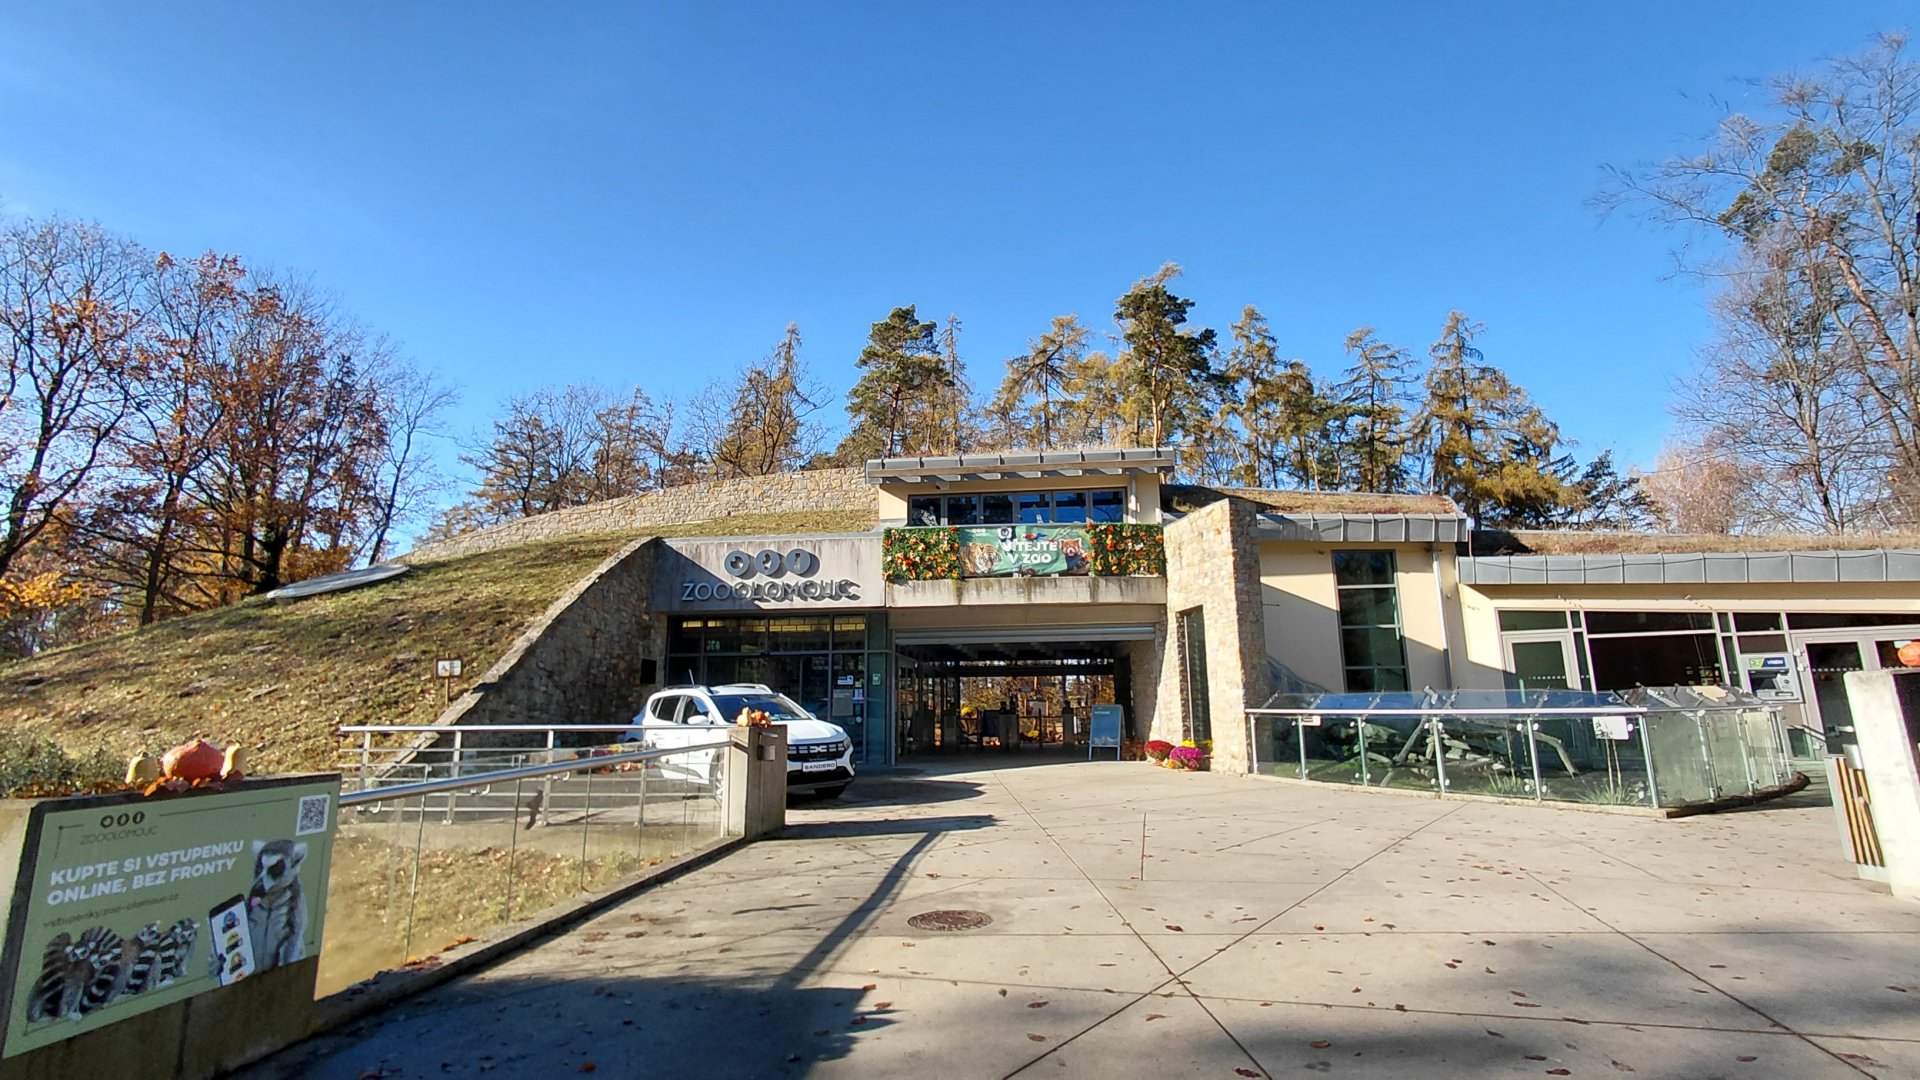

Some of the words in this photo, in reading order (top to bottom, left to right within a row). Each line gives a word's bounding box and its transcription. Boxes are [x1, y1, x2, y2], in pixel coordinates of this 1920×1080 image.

[1007, 553, 1019, 564] V
[1022, 553, 1052, 564] ZOO
[47, 878, 128, 906] ONLINE,
[132, 870, 167, 890] BEZ
[170, 858, 236, 882] FRONTY
[51, 861, 119, 886] KUPTE
[123, 856, 141, 873] SI
[146, 840, 245, 868] VSTUPENKU
